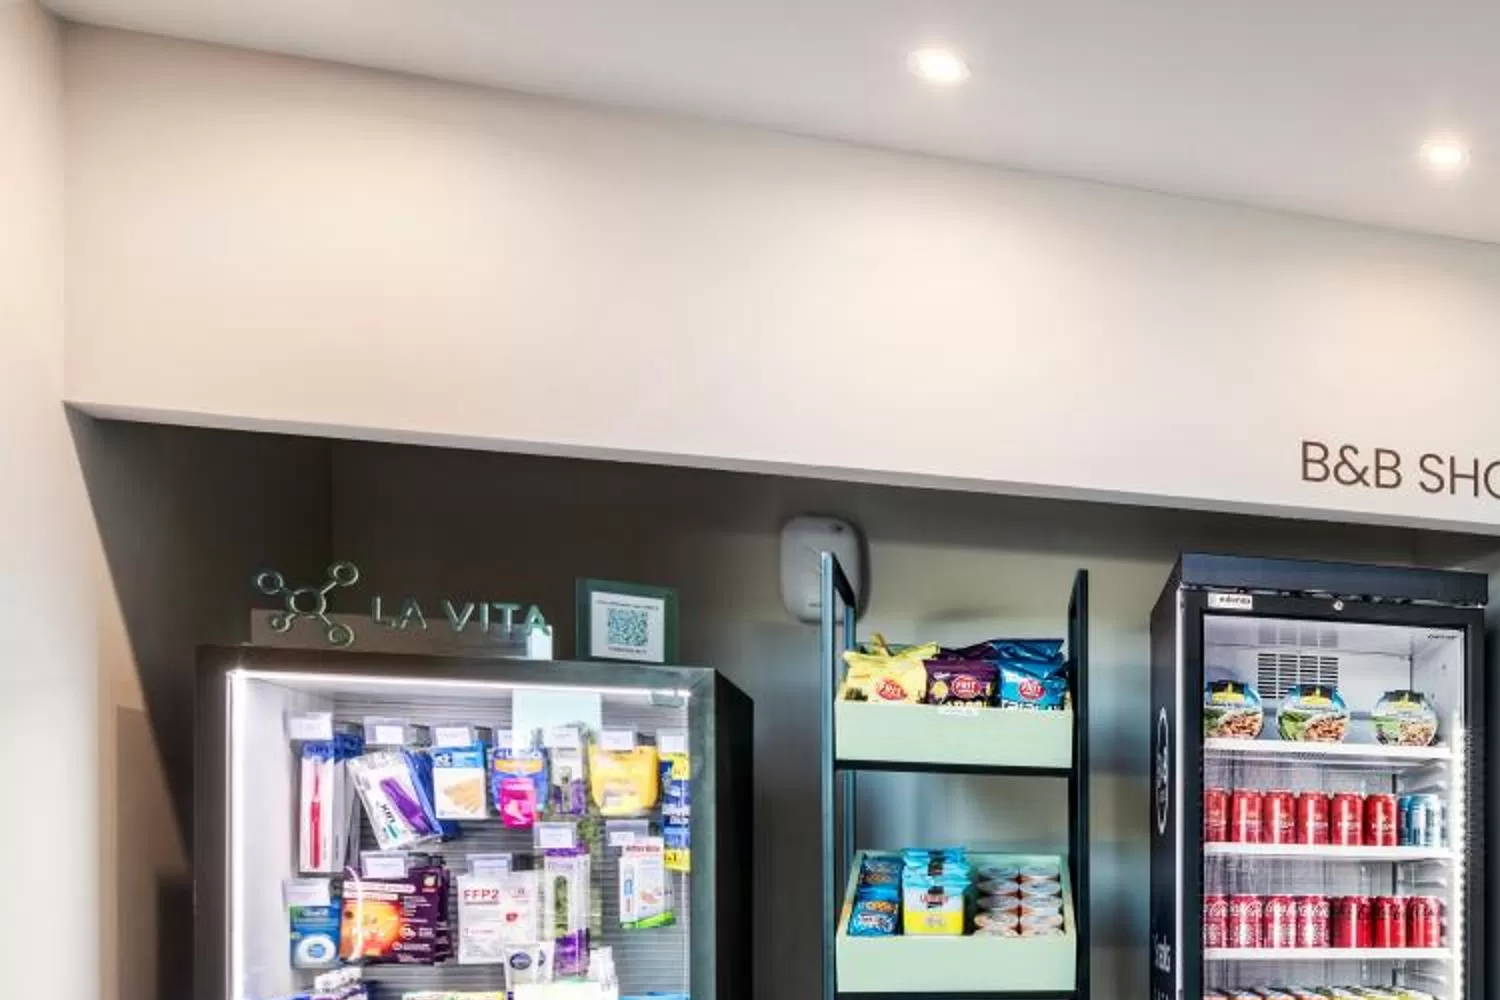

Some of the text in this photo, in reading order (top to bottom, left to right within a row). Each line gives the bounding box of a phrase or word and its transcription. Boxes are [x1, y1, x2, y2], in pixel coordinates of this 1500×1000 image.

[1301, 440, 1403, 489] B&B
[371, 596, 552, 636] LA VITA
[463, 887, 500, 899] FFP2
